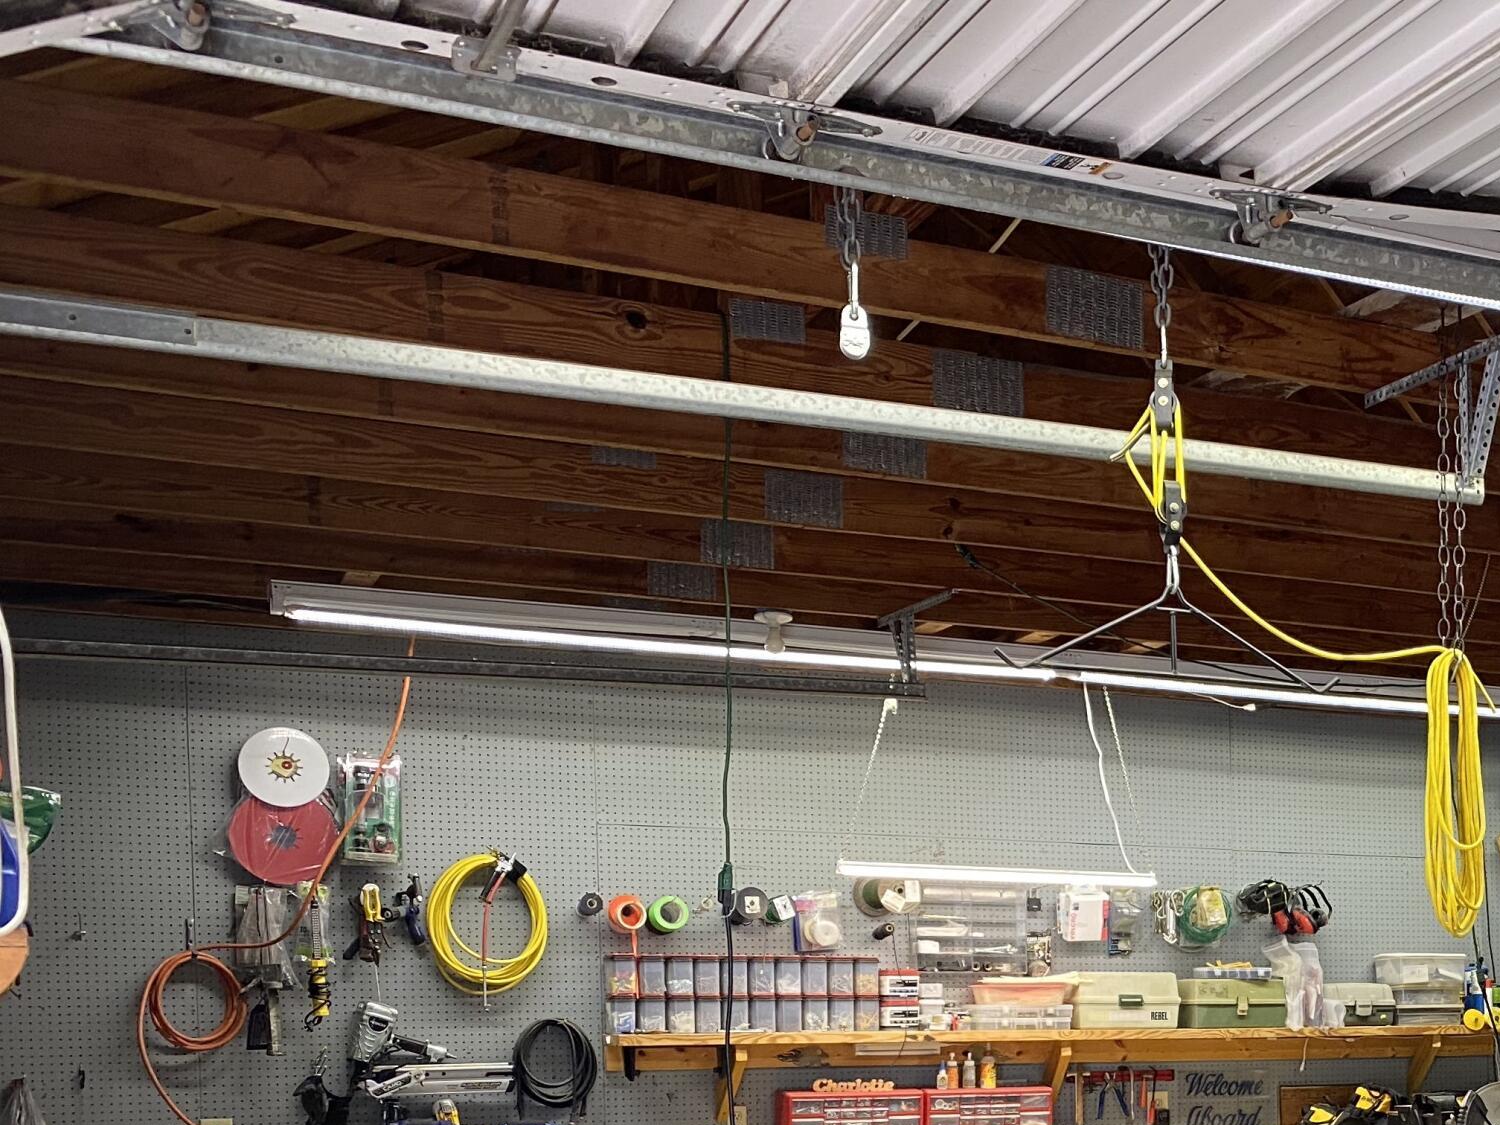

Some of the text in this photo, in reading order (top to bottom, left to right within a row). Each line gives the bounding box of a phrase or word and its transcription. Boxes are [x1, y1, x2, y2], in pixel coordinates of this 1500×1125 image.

[1150, 1011, 1168, 1021] REBEL
[813, 1078, 895, 1093] Charlotte
[1185, 1072, 1264, 1097] Welcome
